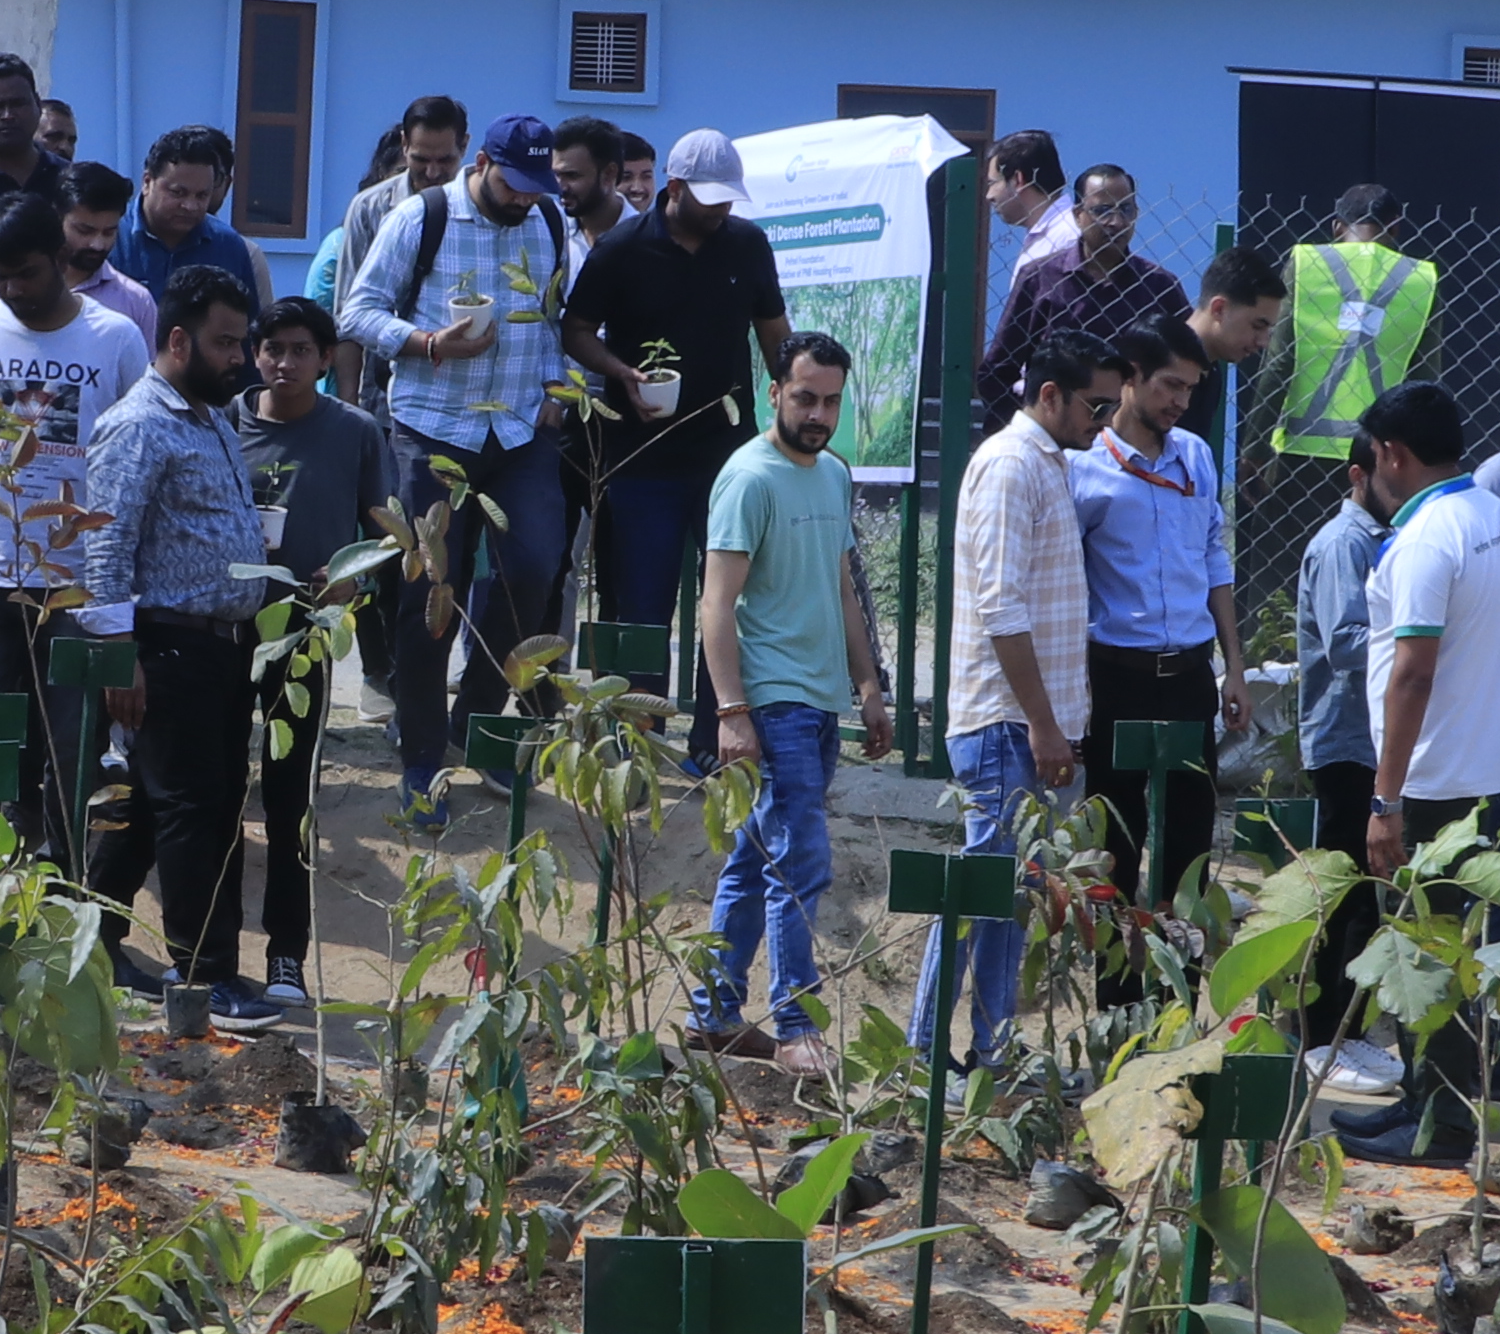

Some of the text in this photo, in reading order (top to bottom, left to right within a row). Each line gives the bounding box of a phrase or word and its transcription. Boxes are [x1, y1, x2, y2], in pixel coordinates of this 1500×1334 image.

[777, 224, 804, 241] Dense
[804, 219, 833, 239] Forest
[833, 212, 880, 236] Plantation
[37, 441, 86, 459] ENSION
